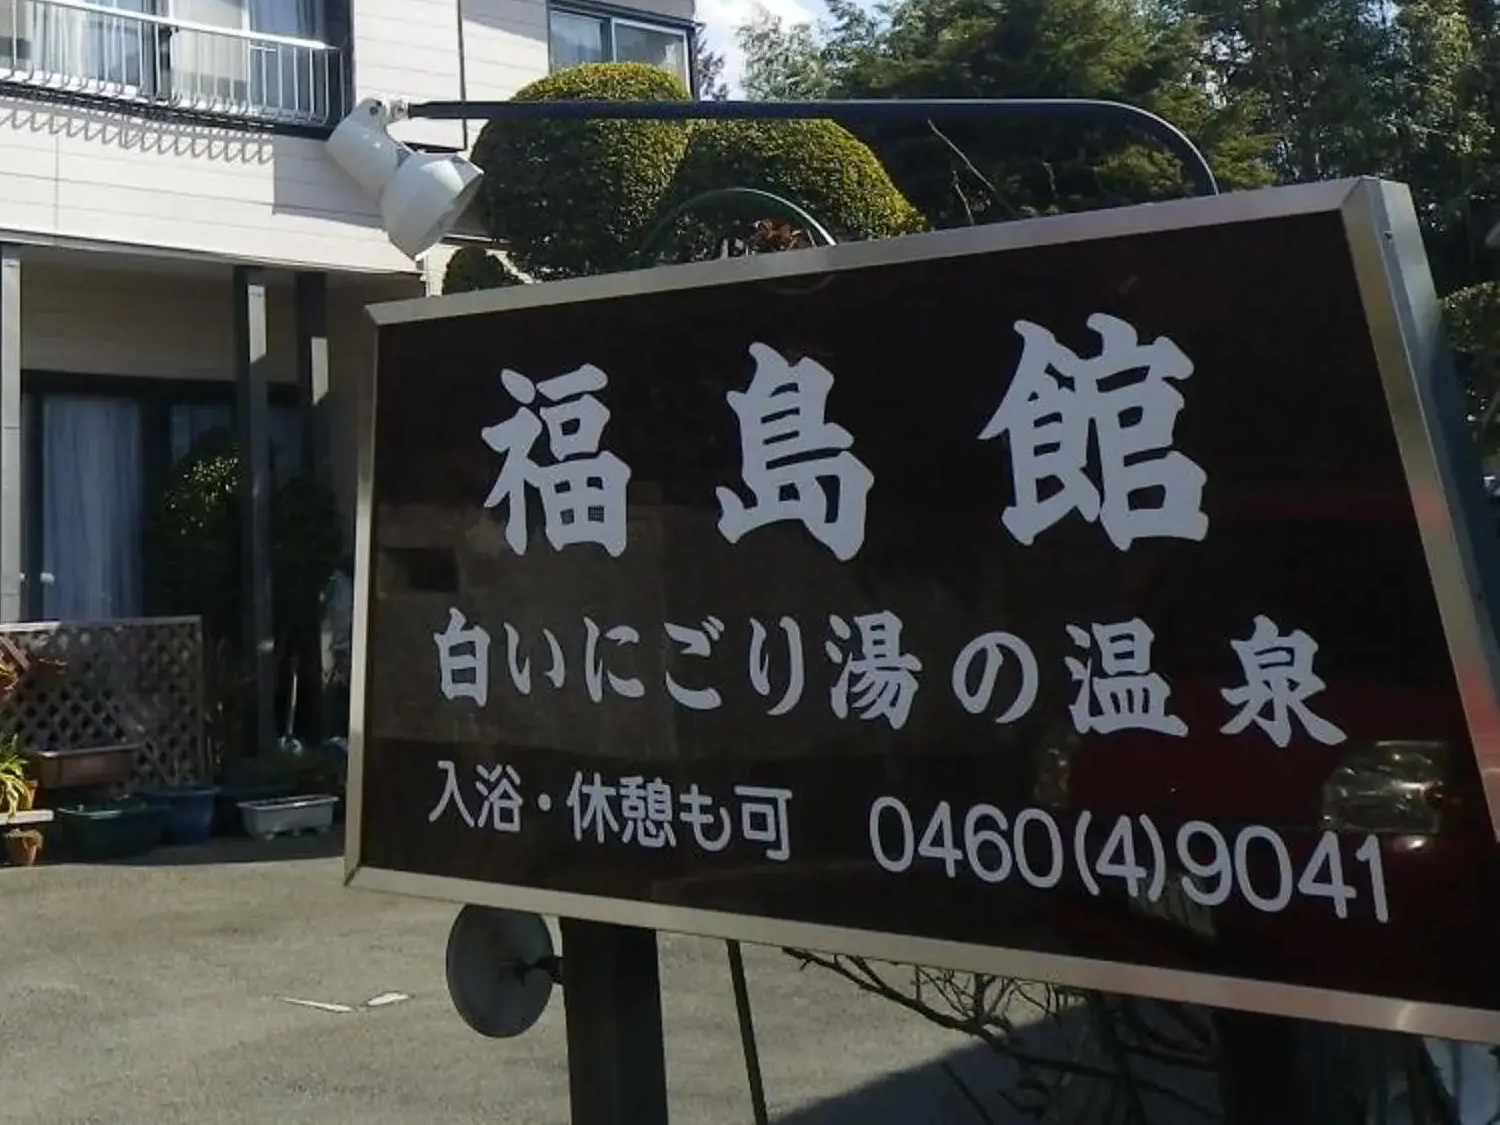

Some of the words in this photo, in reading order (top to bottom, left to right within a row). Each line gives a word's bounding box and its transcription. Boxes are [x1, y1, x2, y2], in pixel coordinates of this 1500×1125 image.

[482, 313, 1208, 561] 福島館
[434, 607, 1346, 748] 白いにごり湯の温泉
[428, 760, 793, 861] 入浴・休憩も可
[870, 797, 1389, 923] 0460(4)9041
